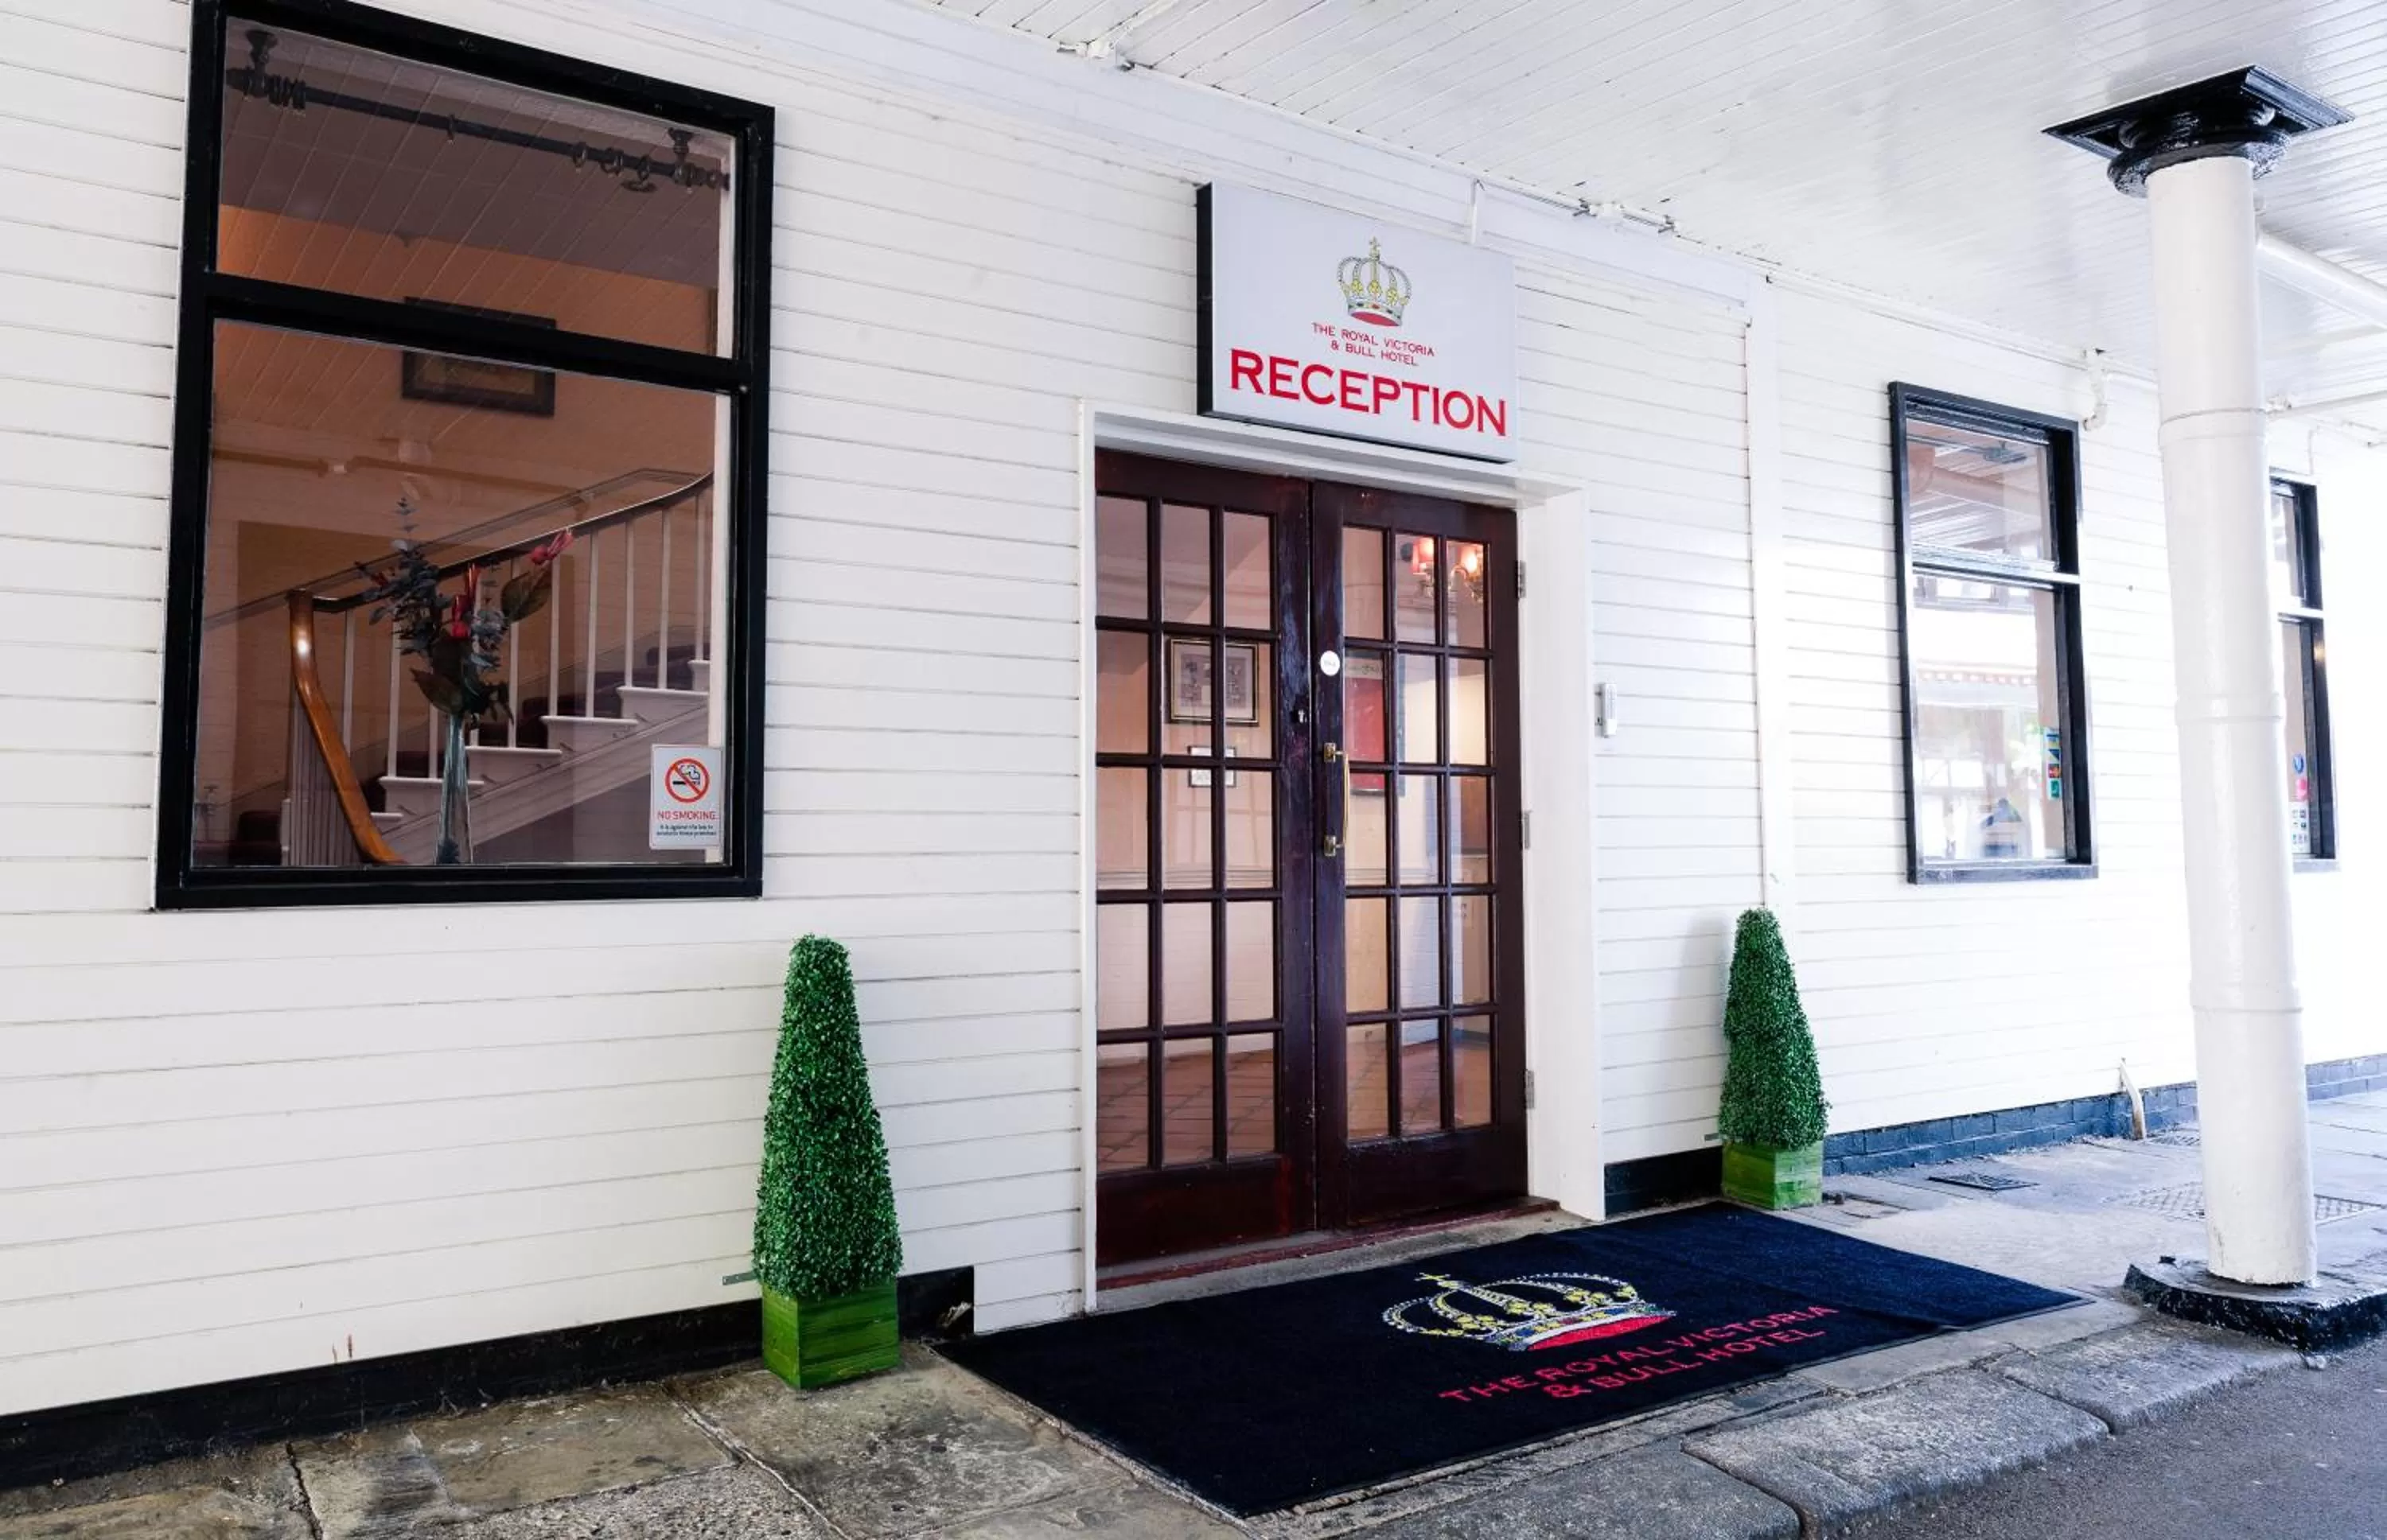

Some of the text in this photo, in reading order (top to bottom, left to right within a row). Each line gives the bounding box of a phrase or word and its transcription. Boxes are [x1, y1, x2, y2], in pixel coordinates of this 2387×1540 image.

[1311, 322, 1435, 357] THE ROYAL VICTORIA
[1330, 340, 1419, 367] & BULL HOTEL
[1230, 348, 1506, 437] RECEPTION
[657, 811, 716, 820] NO SMOKING
[1439, 1305, 1840, 1402] THE ROYAL VICTORIA
[1543, 1328, 1827, 1398] & BULL HOTEL
